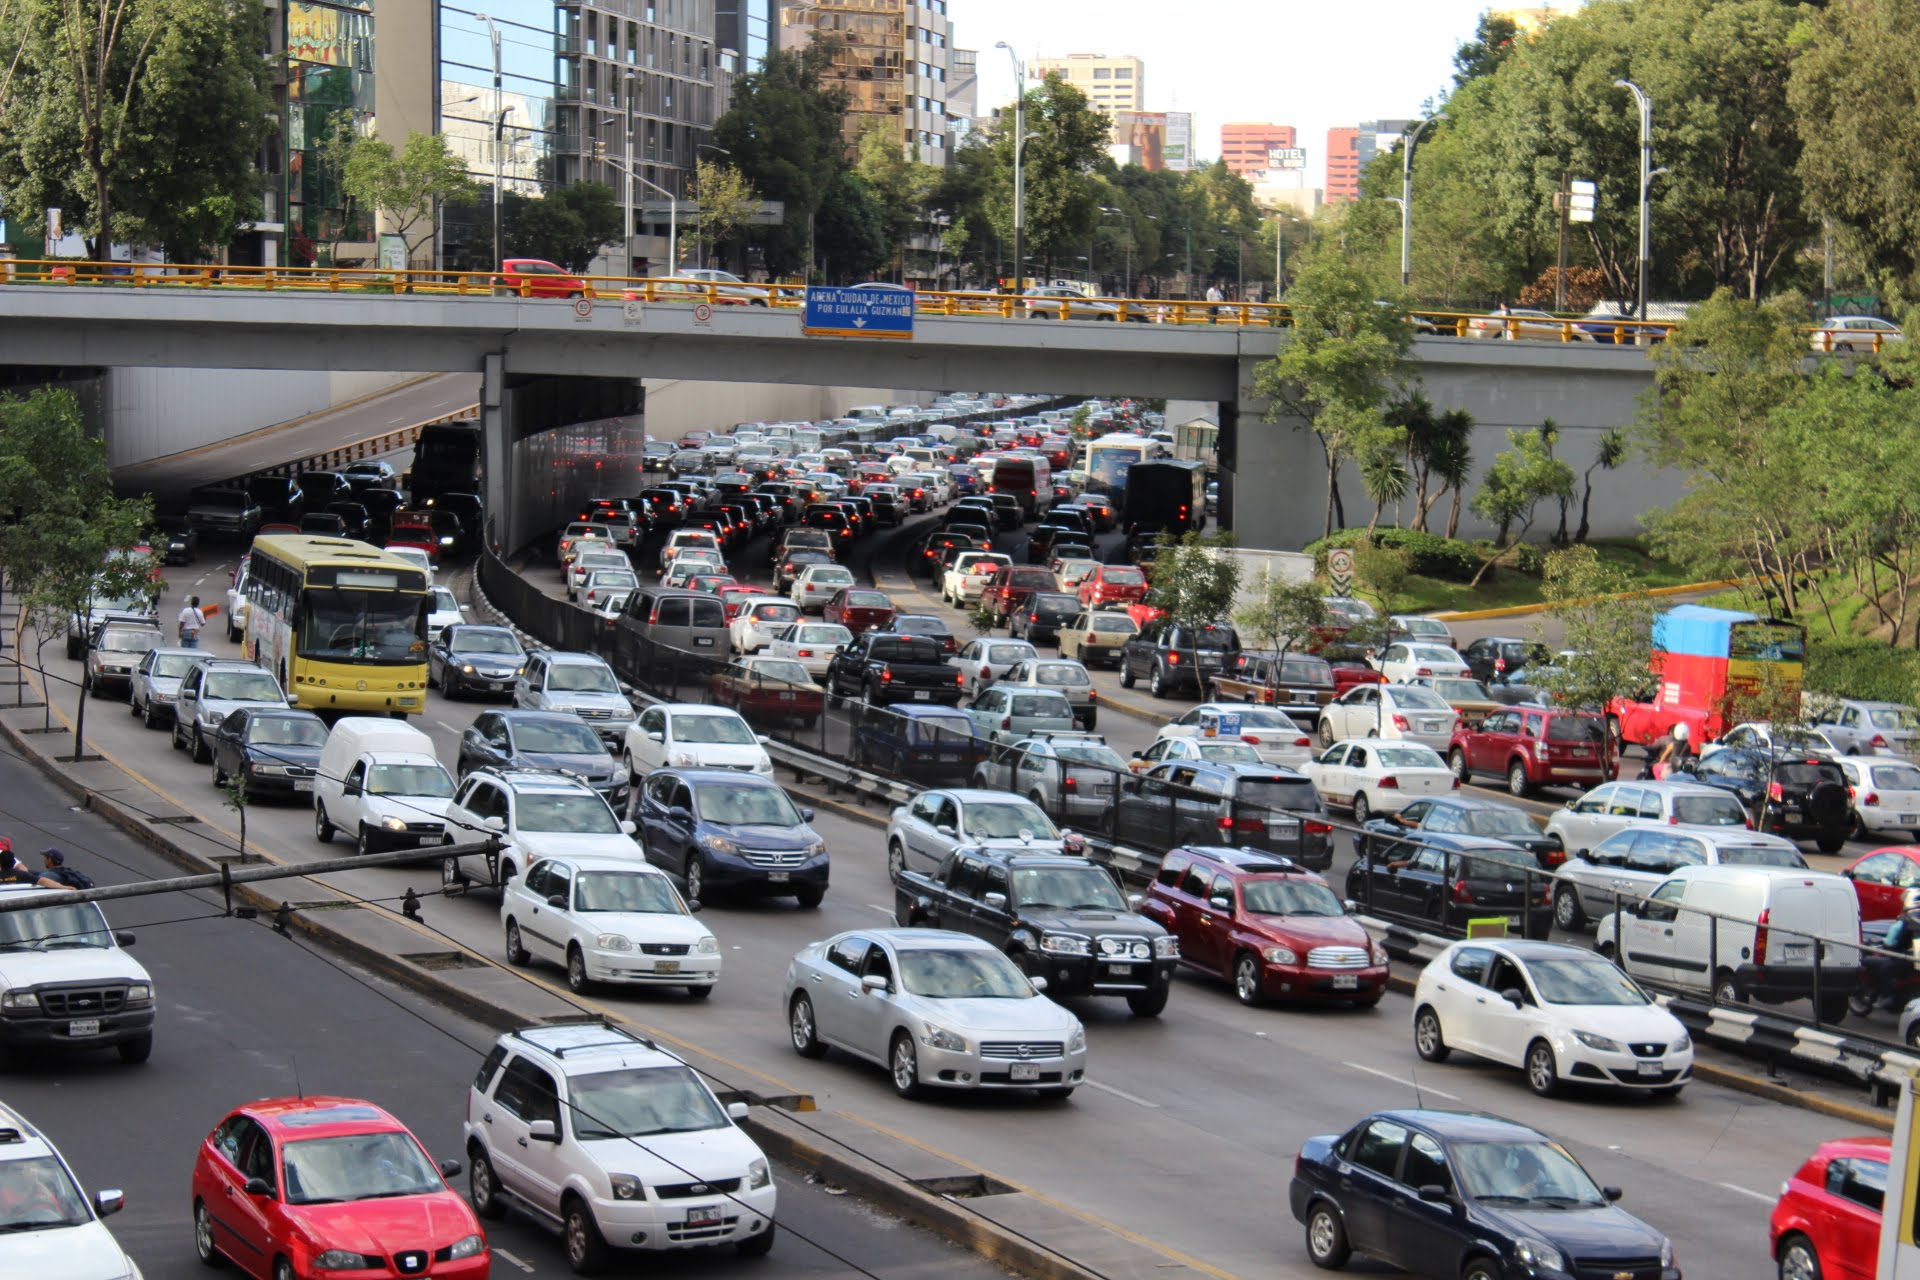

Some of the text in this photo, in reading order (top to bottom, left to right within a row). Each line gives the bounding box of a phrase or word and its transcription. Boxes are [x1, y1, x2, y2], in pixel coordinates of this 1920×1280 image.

[1268, 149, 1305, 159] HOTEL
[810, 291, 911, 306] ARENA CIUDAD DE MEXICO
[817, 304, 902, 316] POR EULALIA GUZMAN
